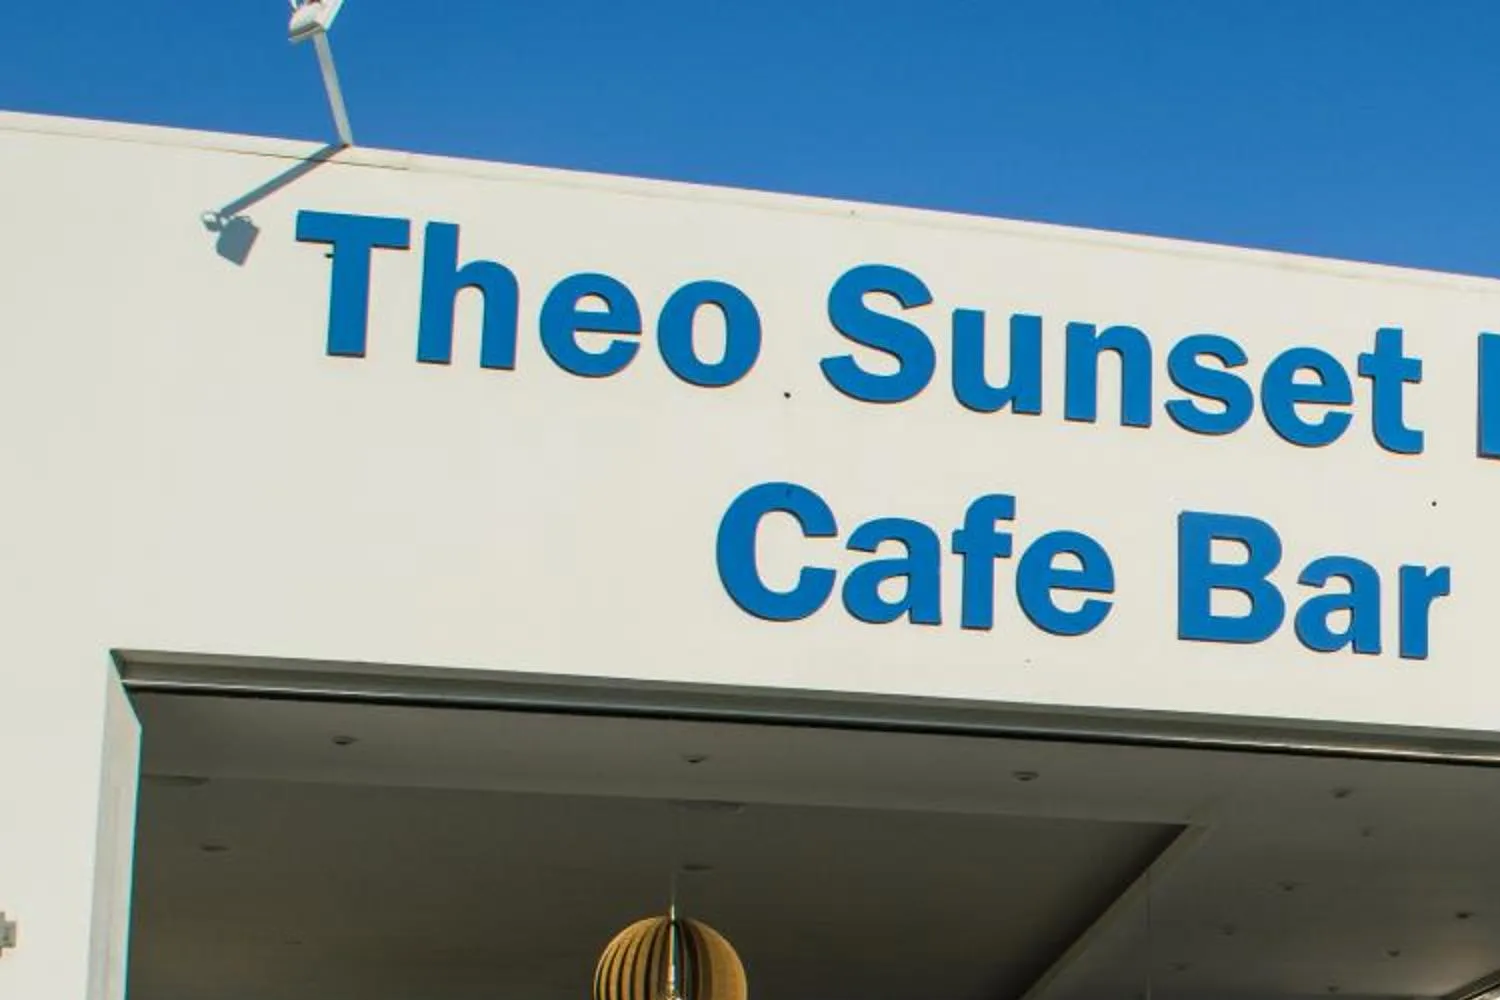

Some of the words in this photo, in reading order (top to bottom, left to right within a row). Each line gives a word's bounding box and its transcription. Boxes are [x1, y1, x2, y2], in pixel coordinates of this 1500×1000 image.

[294, 209, 762, 385] Theo
[819, 262, 1425, 453] Sunset
[715, 480, 1116, 635] Cafe
[1178, 510, 1452, 658] Bar
